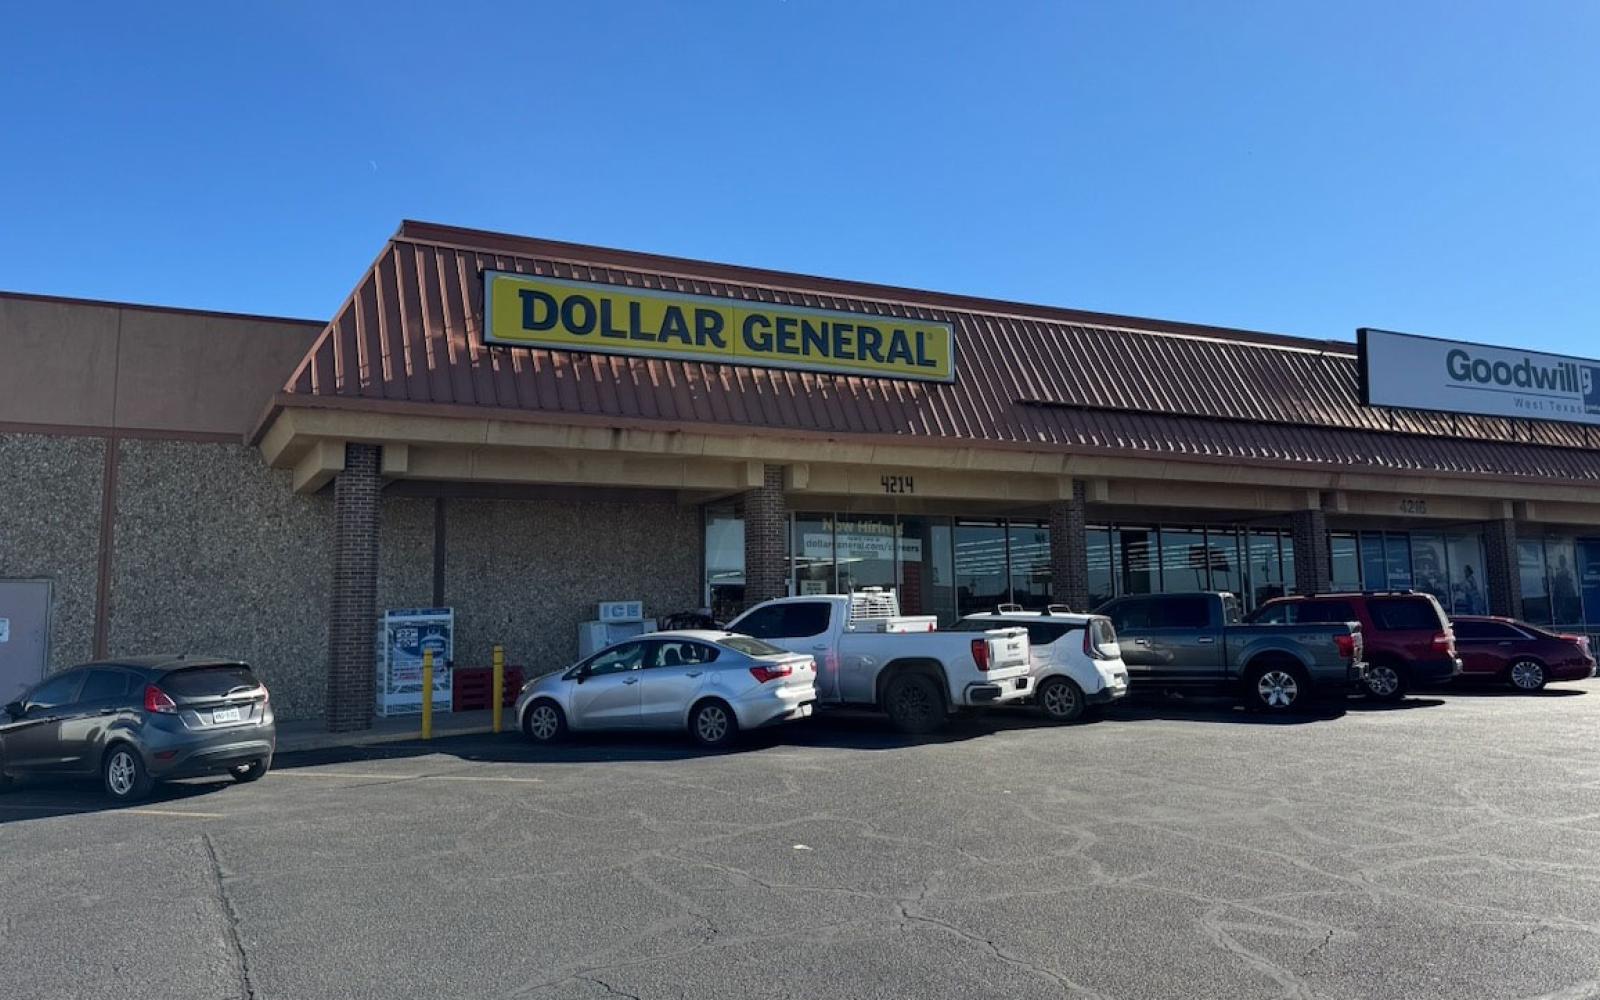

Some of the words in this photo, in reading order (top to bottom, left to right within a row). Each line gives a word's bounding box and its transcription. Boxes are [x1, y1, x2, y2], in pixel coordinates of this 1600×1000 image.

[518, 288, 727, 348] DOLLAR
[741, 313, 937, 368] GENERAL
[1446, 349, 1580, 393] Goodwill
[1513, 397, 1543, 411] West
[1549, 400, 1582, 414] Texas
[881, 475, 914, 494] 4214
[806, 539, 920, 553] dollareneral.com/creers
[603, 605, 639, 618] ICE
